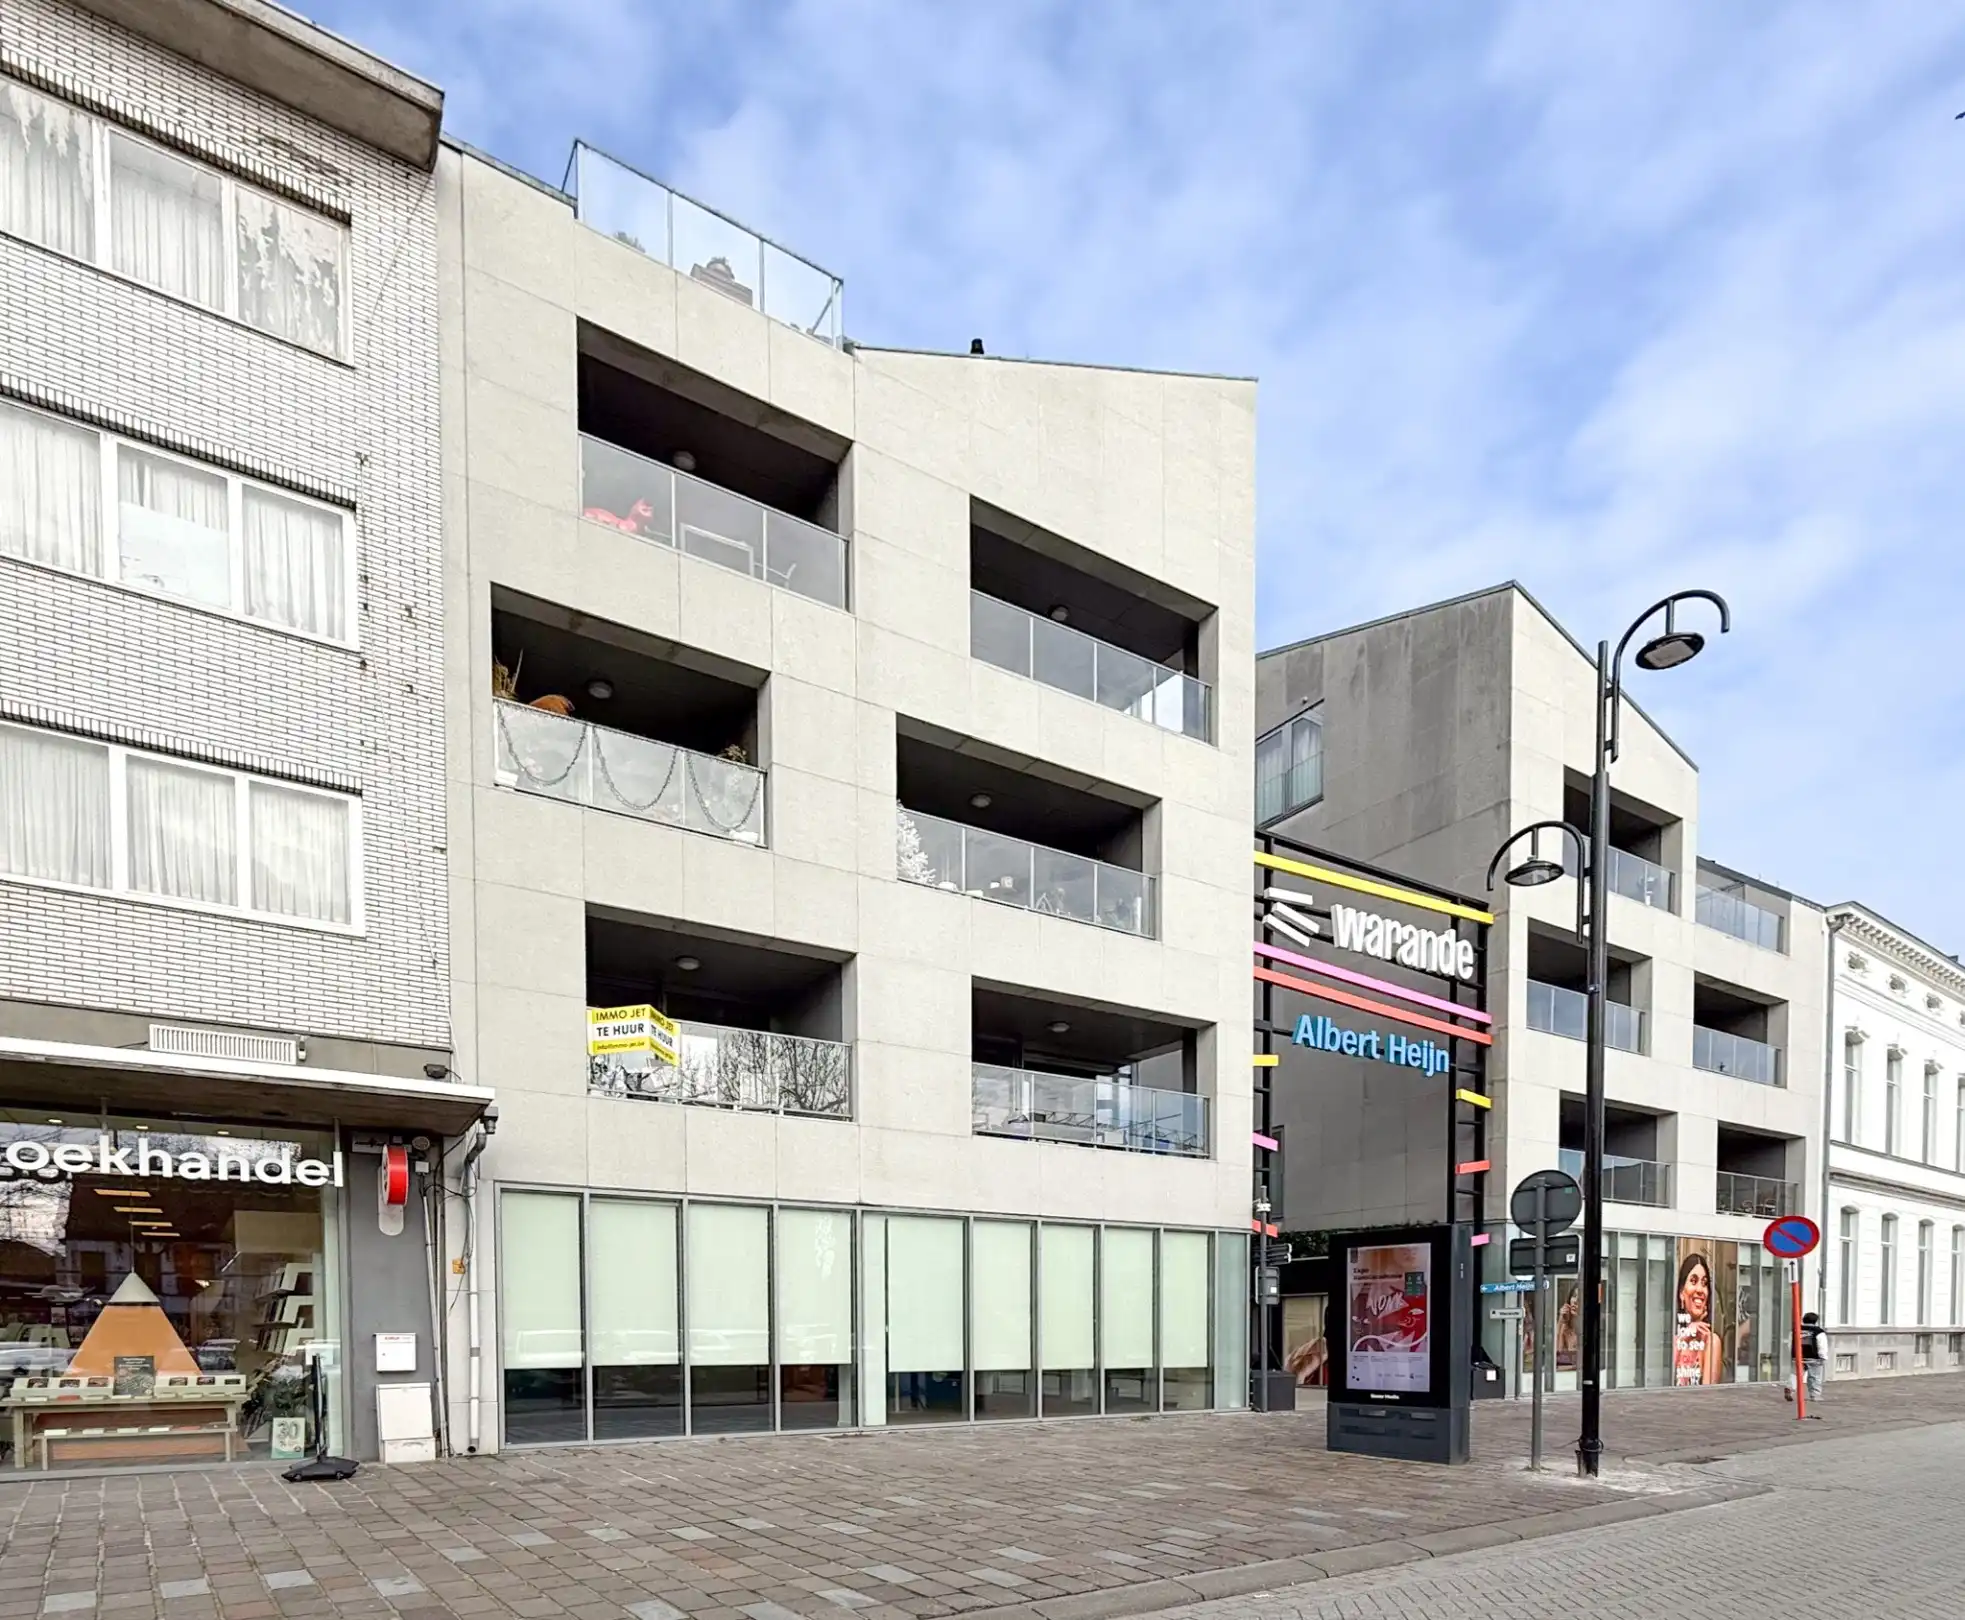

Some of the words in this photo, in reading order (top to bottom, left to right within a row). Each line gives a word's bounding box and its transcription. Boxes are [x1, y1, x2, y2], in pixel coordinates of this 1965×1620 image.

[1330, 903, 1475, 981] warande
[596, 1010, 627, 1021] IMMO
[630, 1008, 646, 1018] JET
[596, 1026, 609, 1037] TE
[613, 1023, 644, 1035] HUUR
[1292, 1013, 1381, 1061] Albert
[1388, 1034, 1449, 1077] Heijn
[1495, 1283, 1515, 1292] Albert
[1677, 1313, 1691, 1323] we
[1677, 1324, 1697, 1337] love
[1677, 1339, 1688, 1350] to
[1689, 1340, 1705, 1351] see
